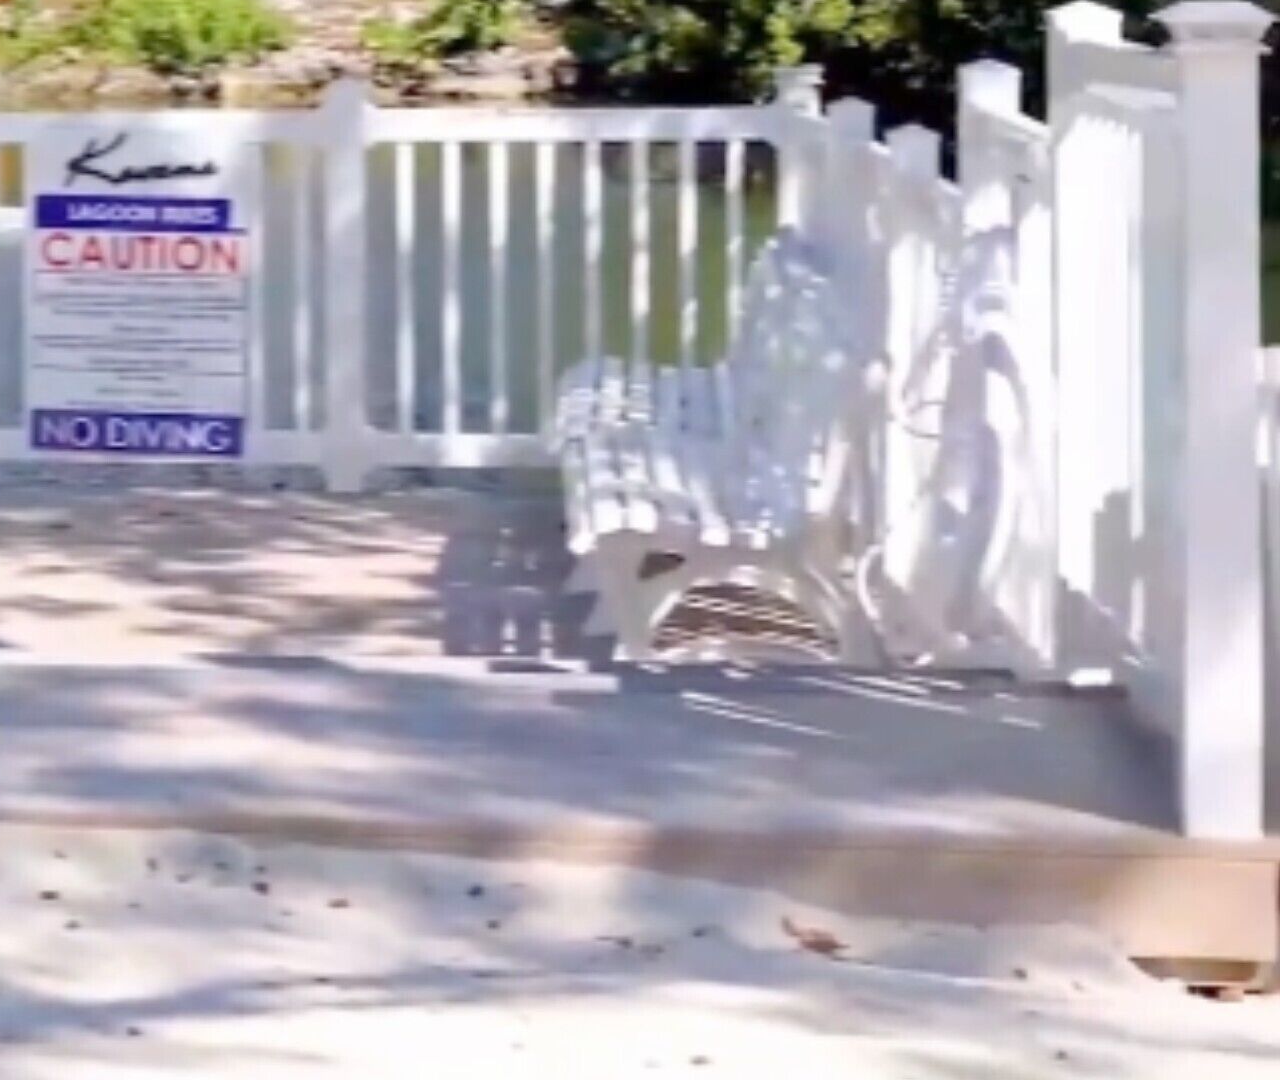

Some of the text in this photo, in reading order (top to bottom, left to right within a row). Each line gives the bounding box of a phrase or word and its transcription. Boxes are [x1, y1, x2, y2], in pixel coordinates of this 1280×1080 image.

[42, 231, 238, 272] CAUTION
[41, 417, 232, 452] NO DIVING
